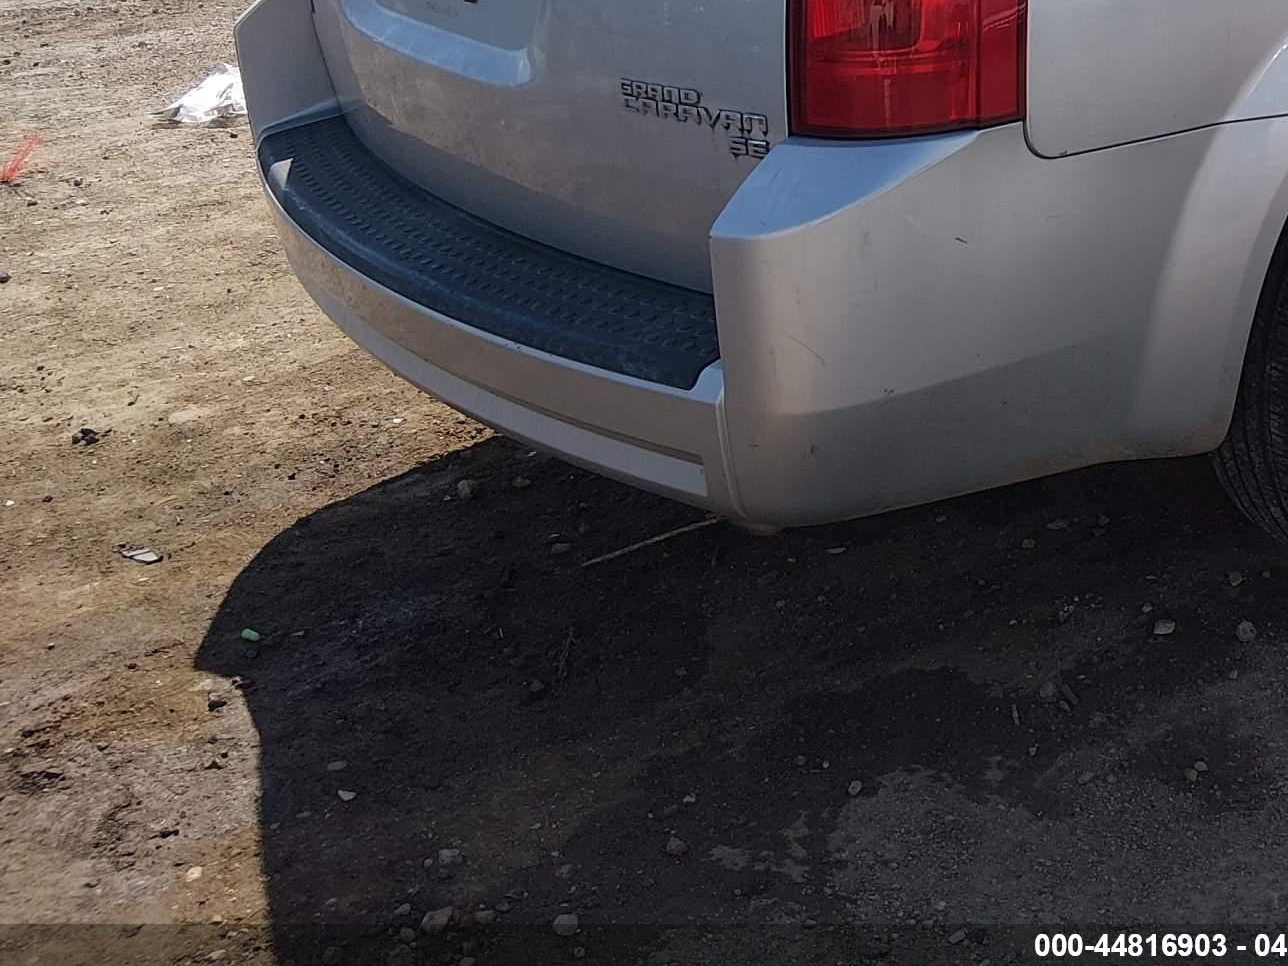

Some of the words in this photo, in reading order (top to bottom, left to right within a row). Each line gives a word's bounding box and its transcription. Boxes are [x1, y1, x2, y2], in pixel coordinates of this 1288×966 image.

[620, 77, 702, 106] GRAND
[623, 95, 769, 137] CARAVAN
[729, 136, 770, 160] SE
